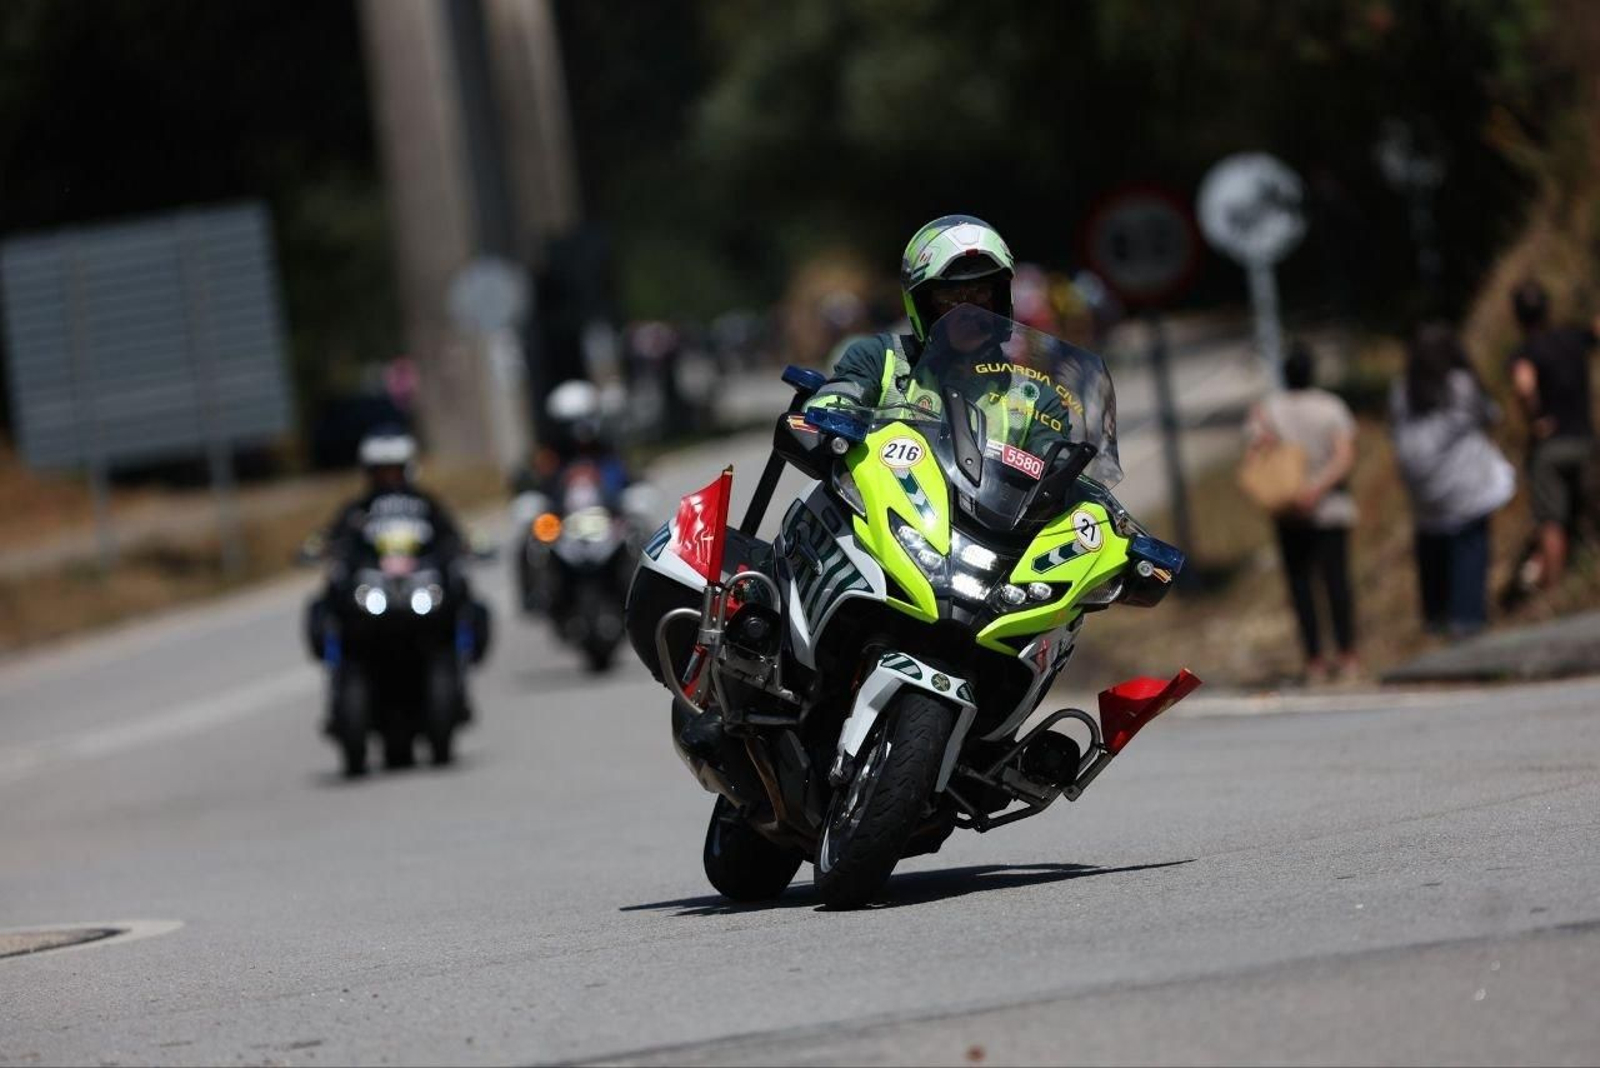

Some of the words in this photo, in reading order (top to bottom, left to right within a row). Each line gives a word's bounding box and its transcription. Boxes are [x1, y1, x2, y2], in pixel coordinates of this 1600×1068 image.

[975, 363, 1051, 386] GUARDIA
[989, 392, 1062, 431] TICO
[884, 443, 919, 461] 216
[1006, 448, 1041, 475] 5580
